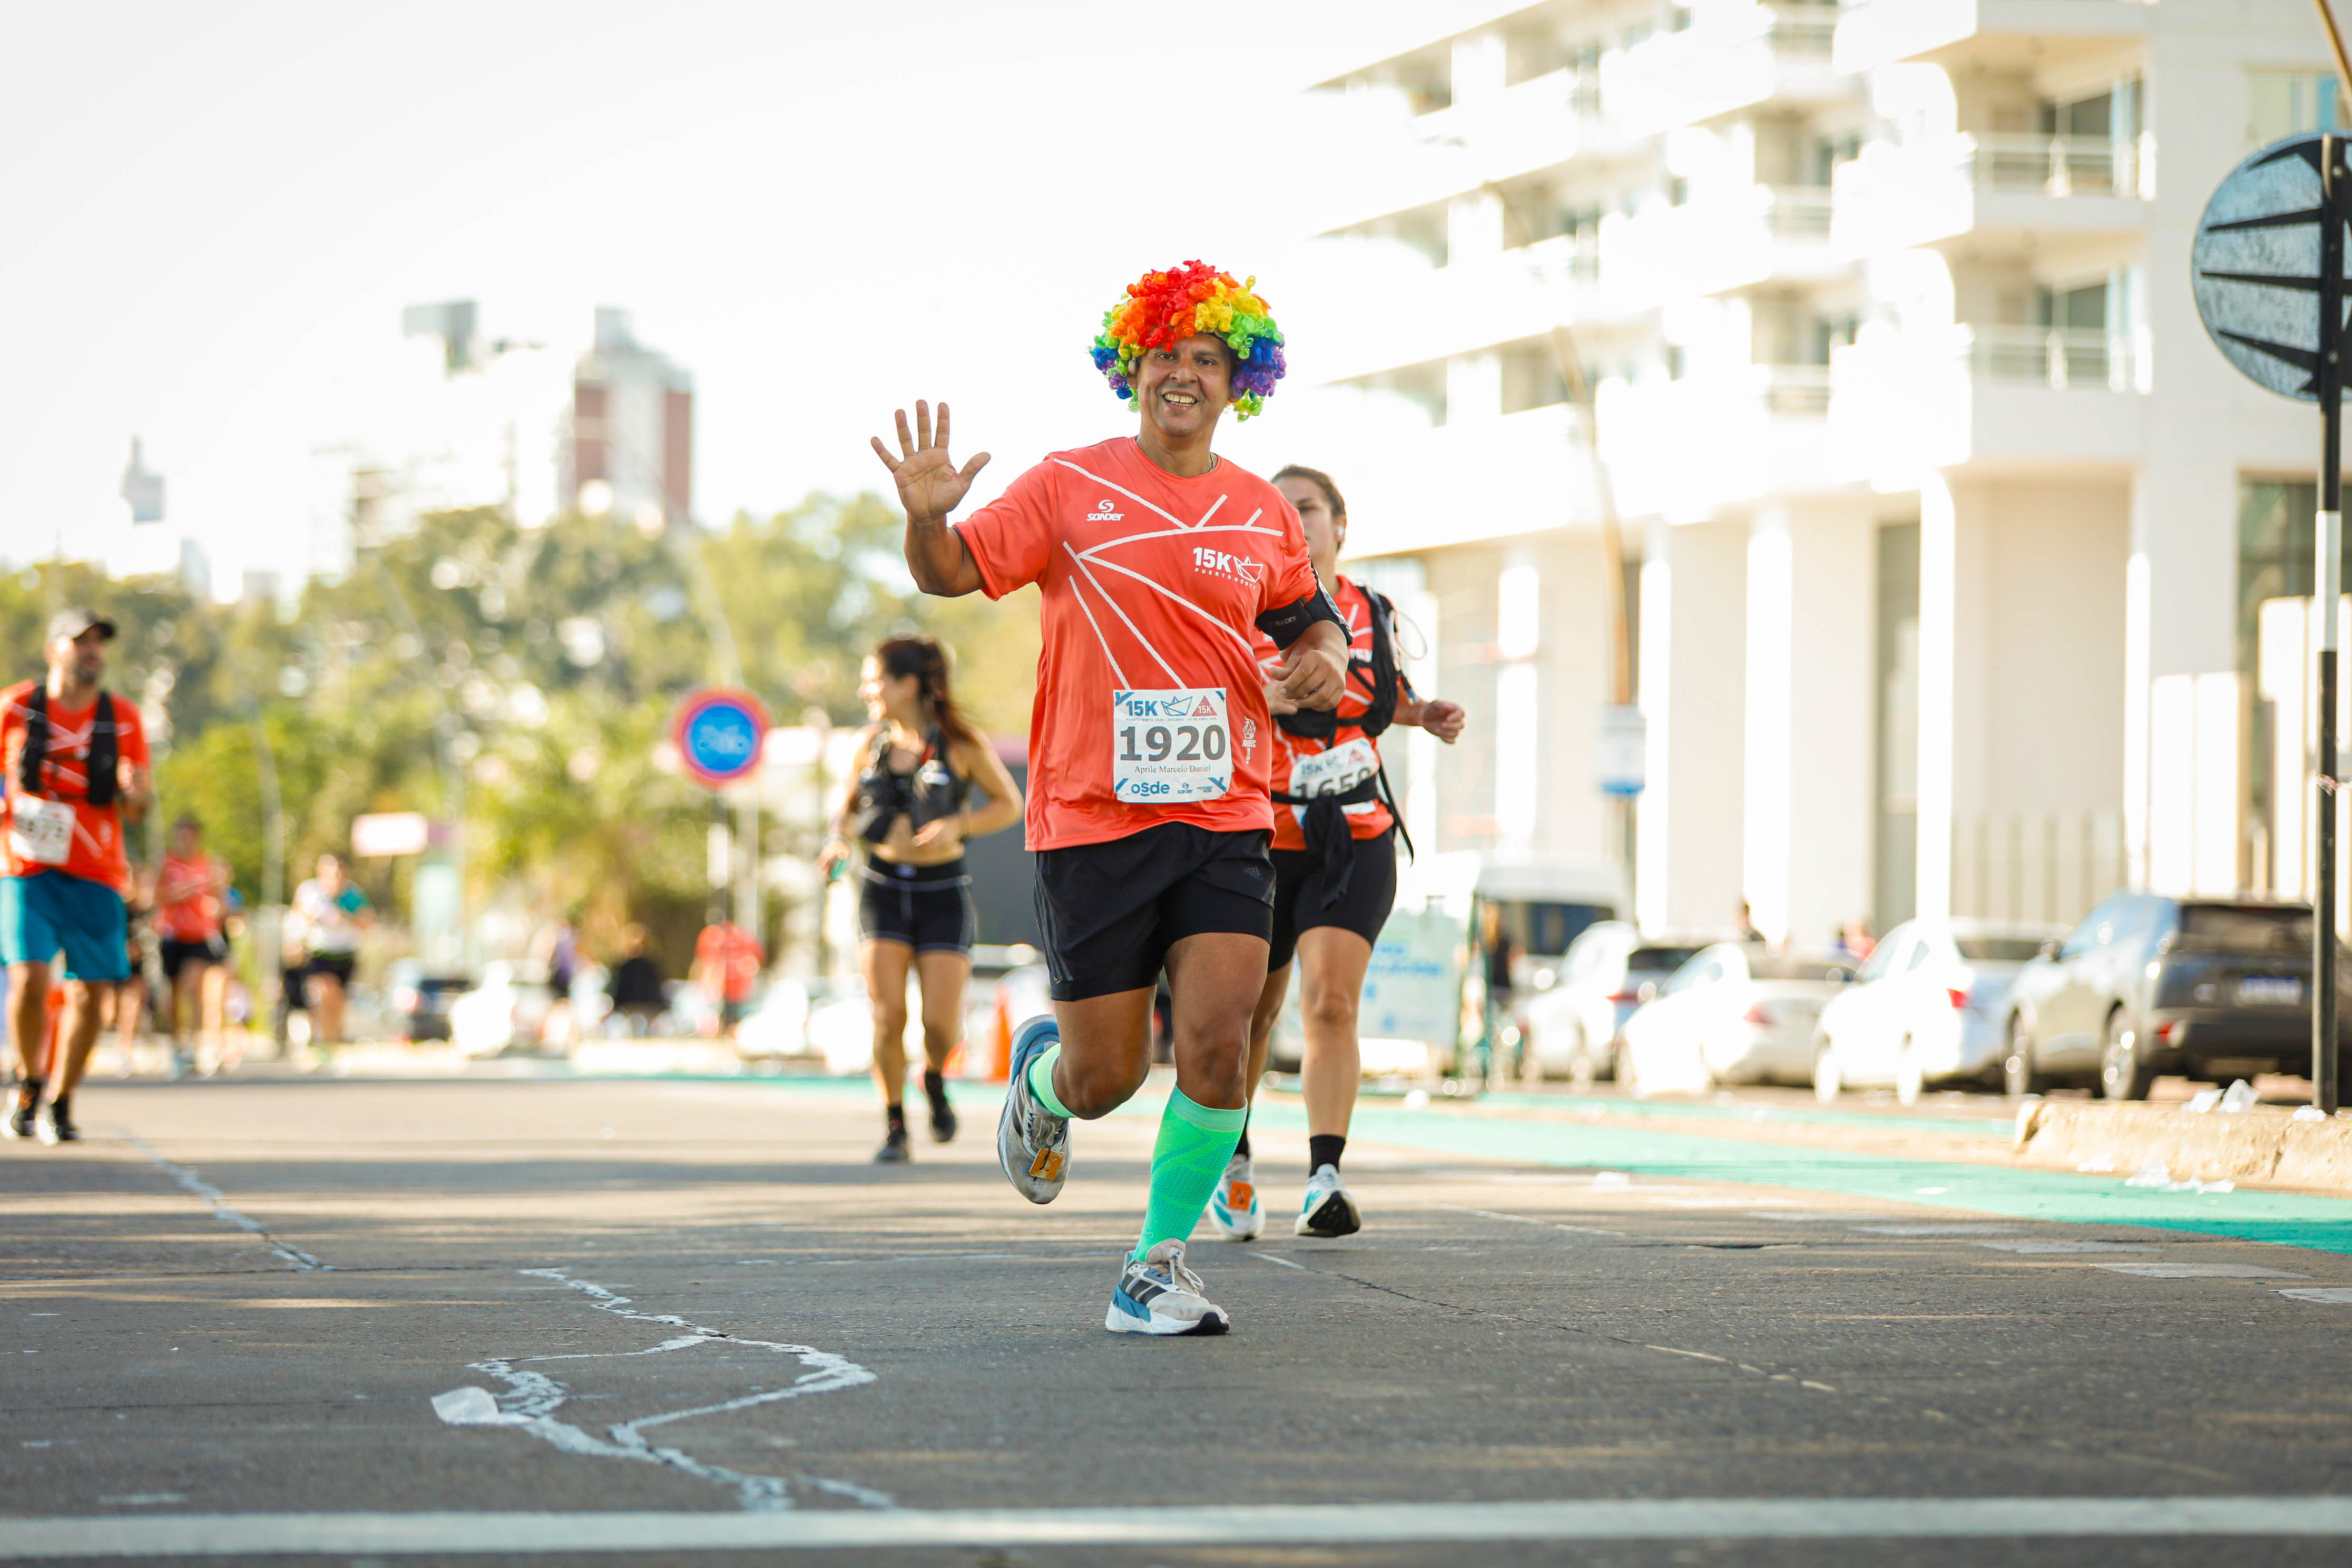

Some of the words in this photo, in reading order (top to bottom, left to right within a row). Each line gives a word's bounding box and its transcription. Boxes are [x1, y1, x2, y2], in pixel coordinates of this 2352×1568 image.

[1193, 547, 1232, 573] 15K
[1195, 567, 1231, 580] PUERTO
[1234, 577, 1256, 590] NORTE
[1126, 701, 1158, 716] 15K
[1198, 705, 1212, 714] 15K
[1120, 724, 1226, 761] 1920
[1242, 739, 1256, 748] ARDEC
[1134, 766, 1157, 774] Aprile
[1131, 781, 1170, 795] osde
